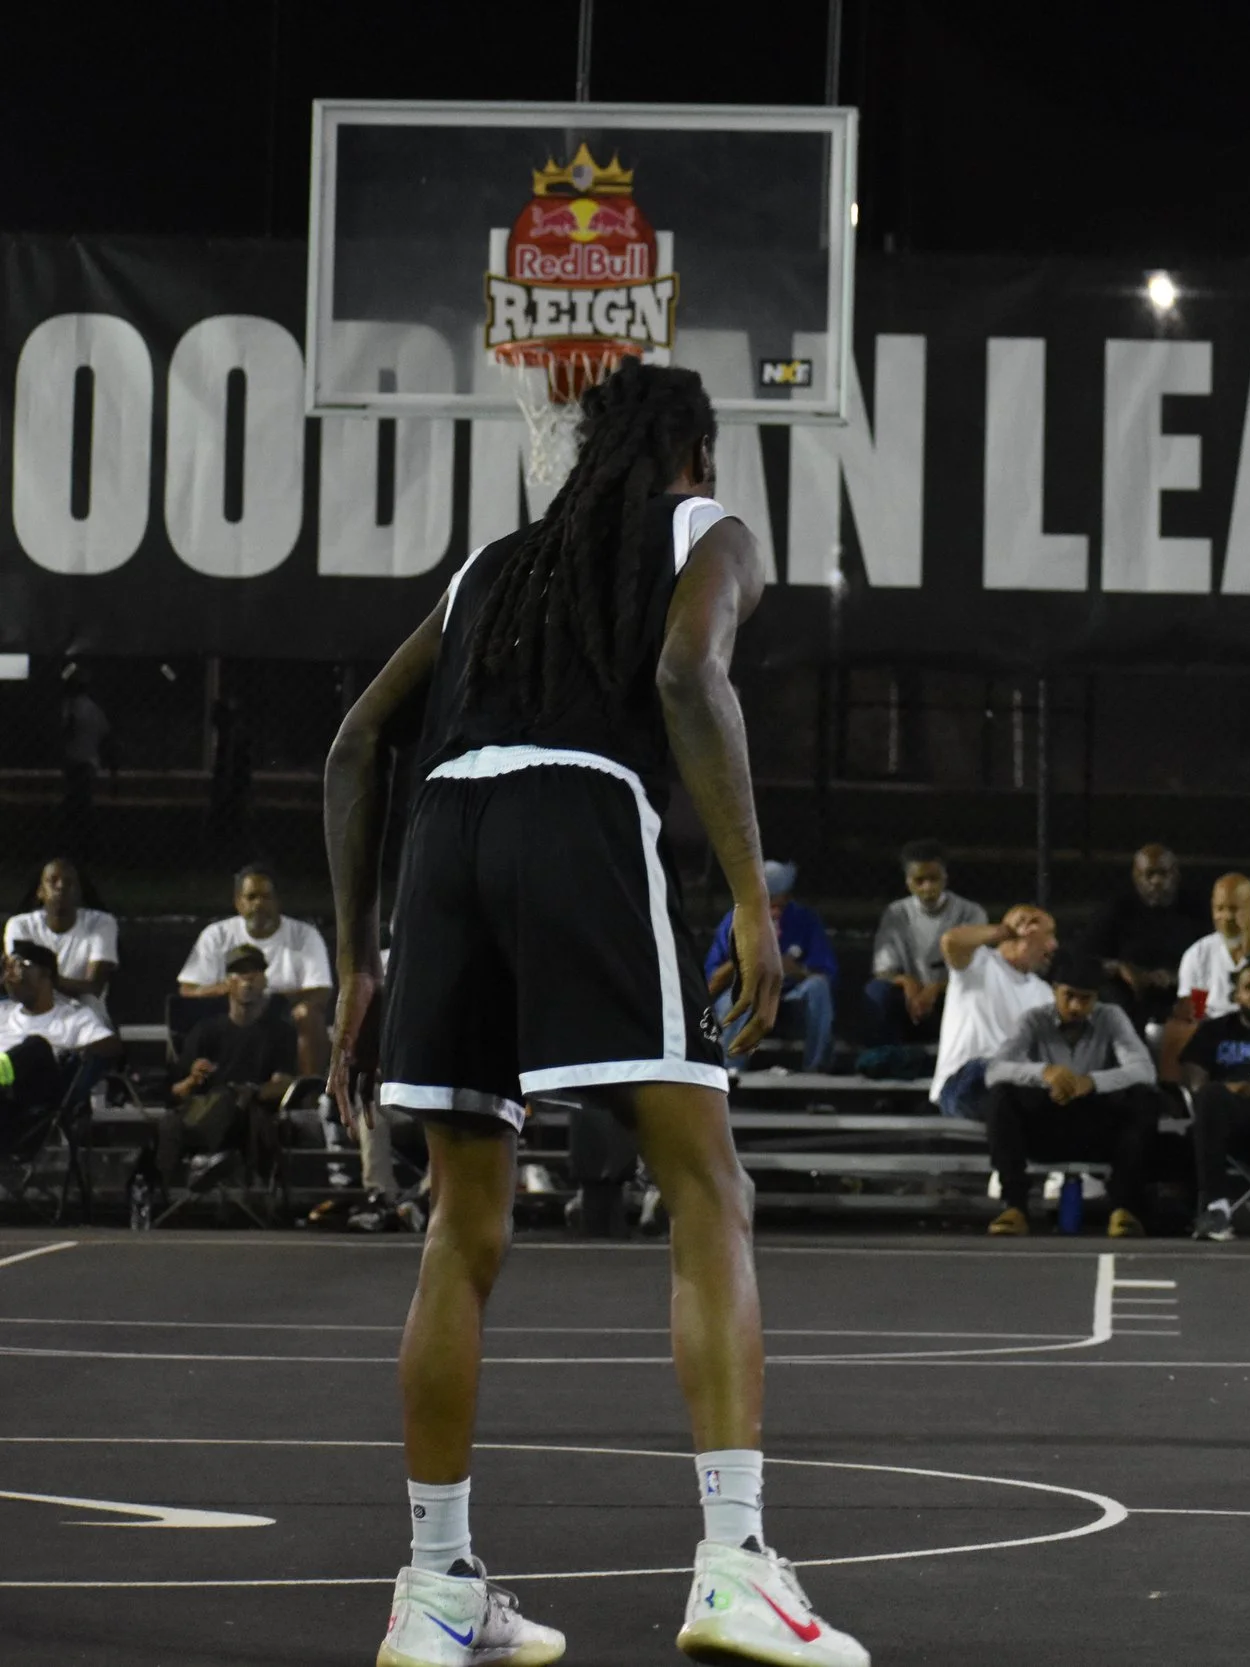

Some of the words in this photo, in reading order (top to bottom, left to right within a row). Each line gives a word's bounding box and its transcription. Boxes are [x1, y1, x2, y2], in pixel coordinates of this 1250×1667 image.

[515, 243, 583, 279] Red
[584, 243, 649, 280] Bull
[489, 277, 674, 346] REIGN
[763, 361, 810, 384] NXT
